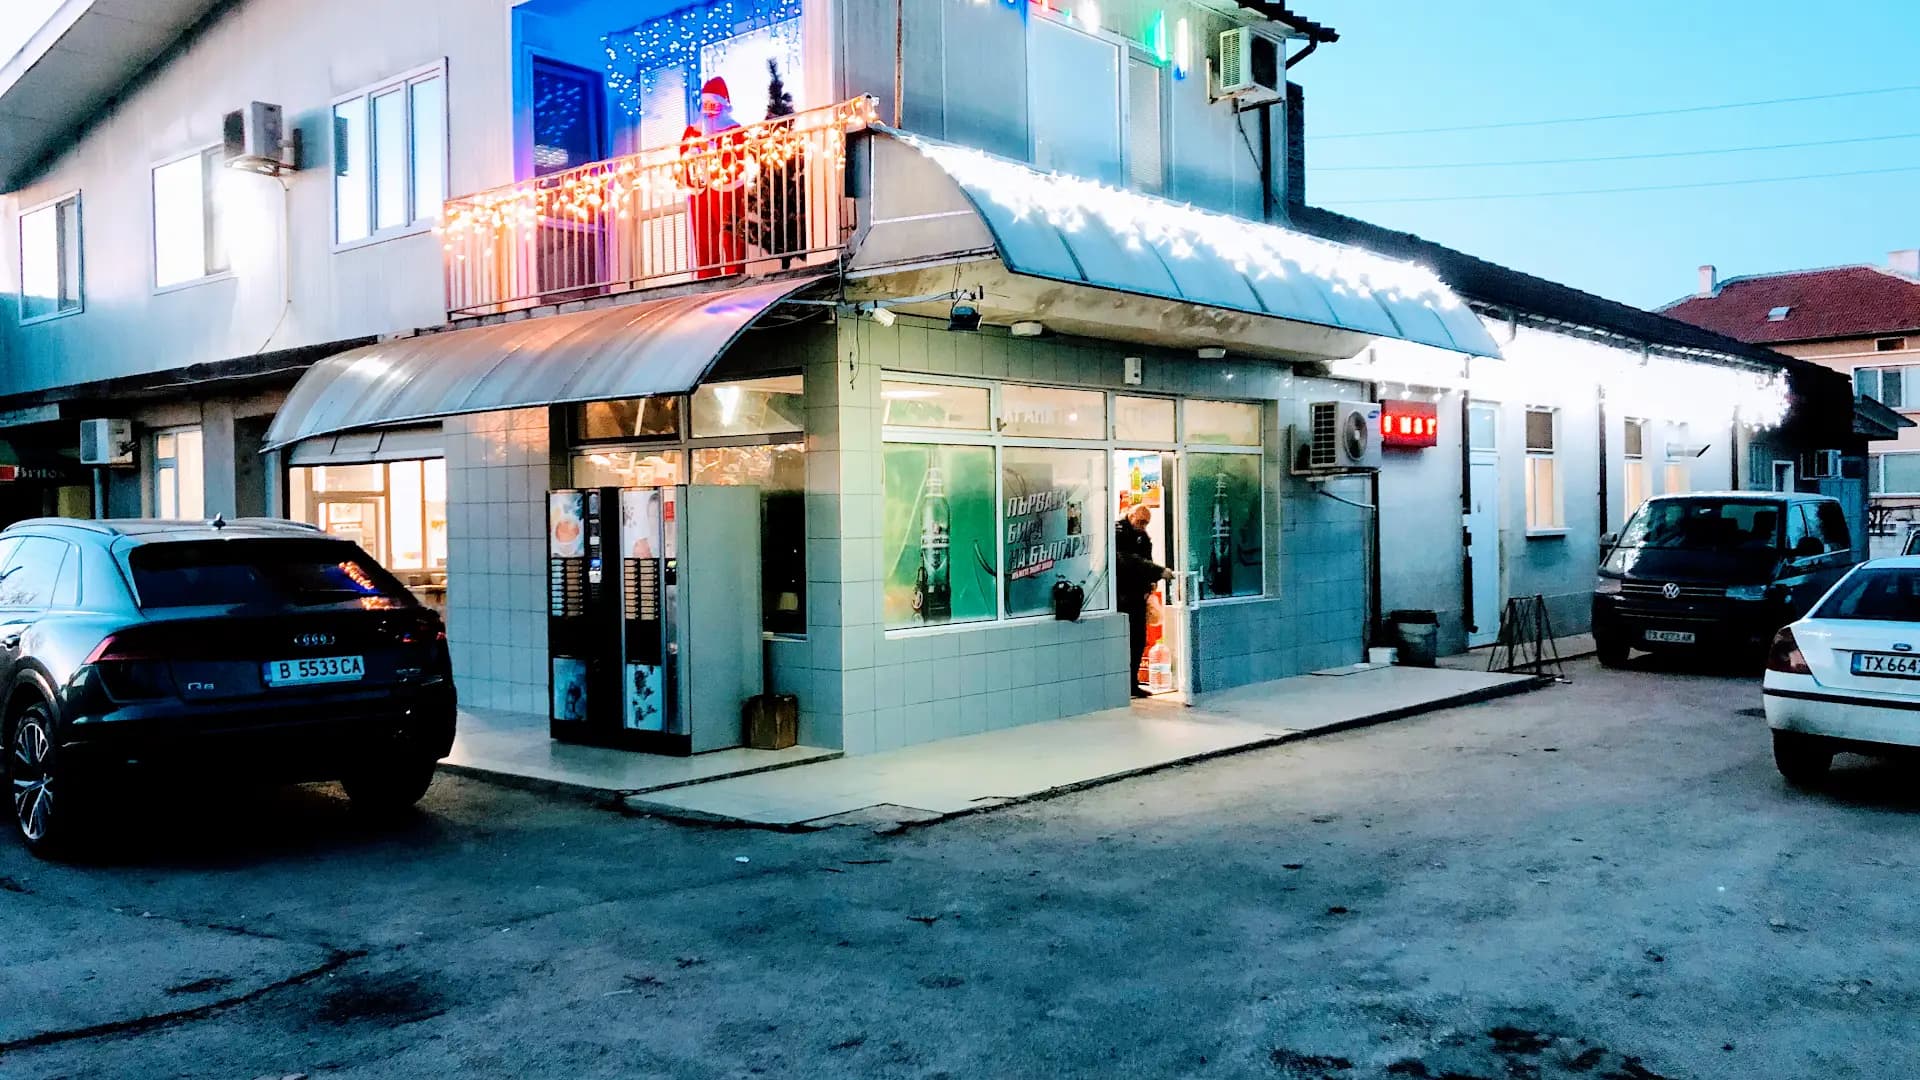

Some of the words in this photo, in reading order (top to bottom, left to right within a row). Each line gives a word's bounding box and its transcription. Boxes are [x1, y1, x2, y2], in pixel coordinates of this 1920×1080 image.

[280, 663, 290, 679] B
[299, 660, 338, 678] 5533
[341, 658, 362, 675] CA
[1864, 656, 1884, 671] TX
[1887, 657, 1920, 674] 664
